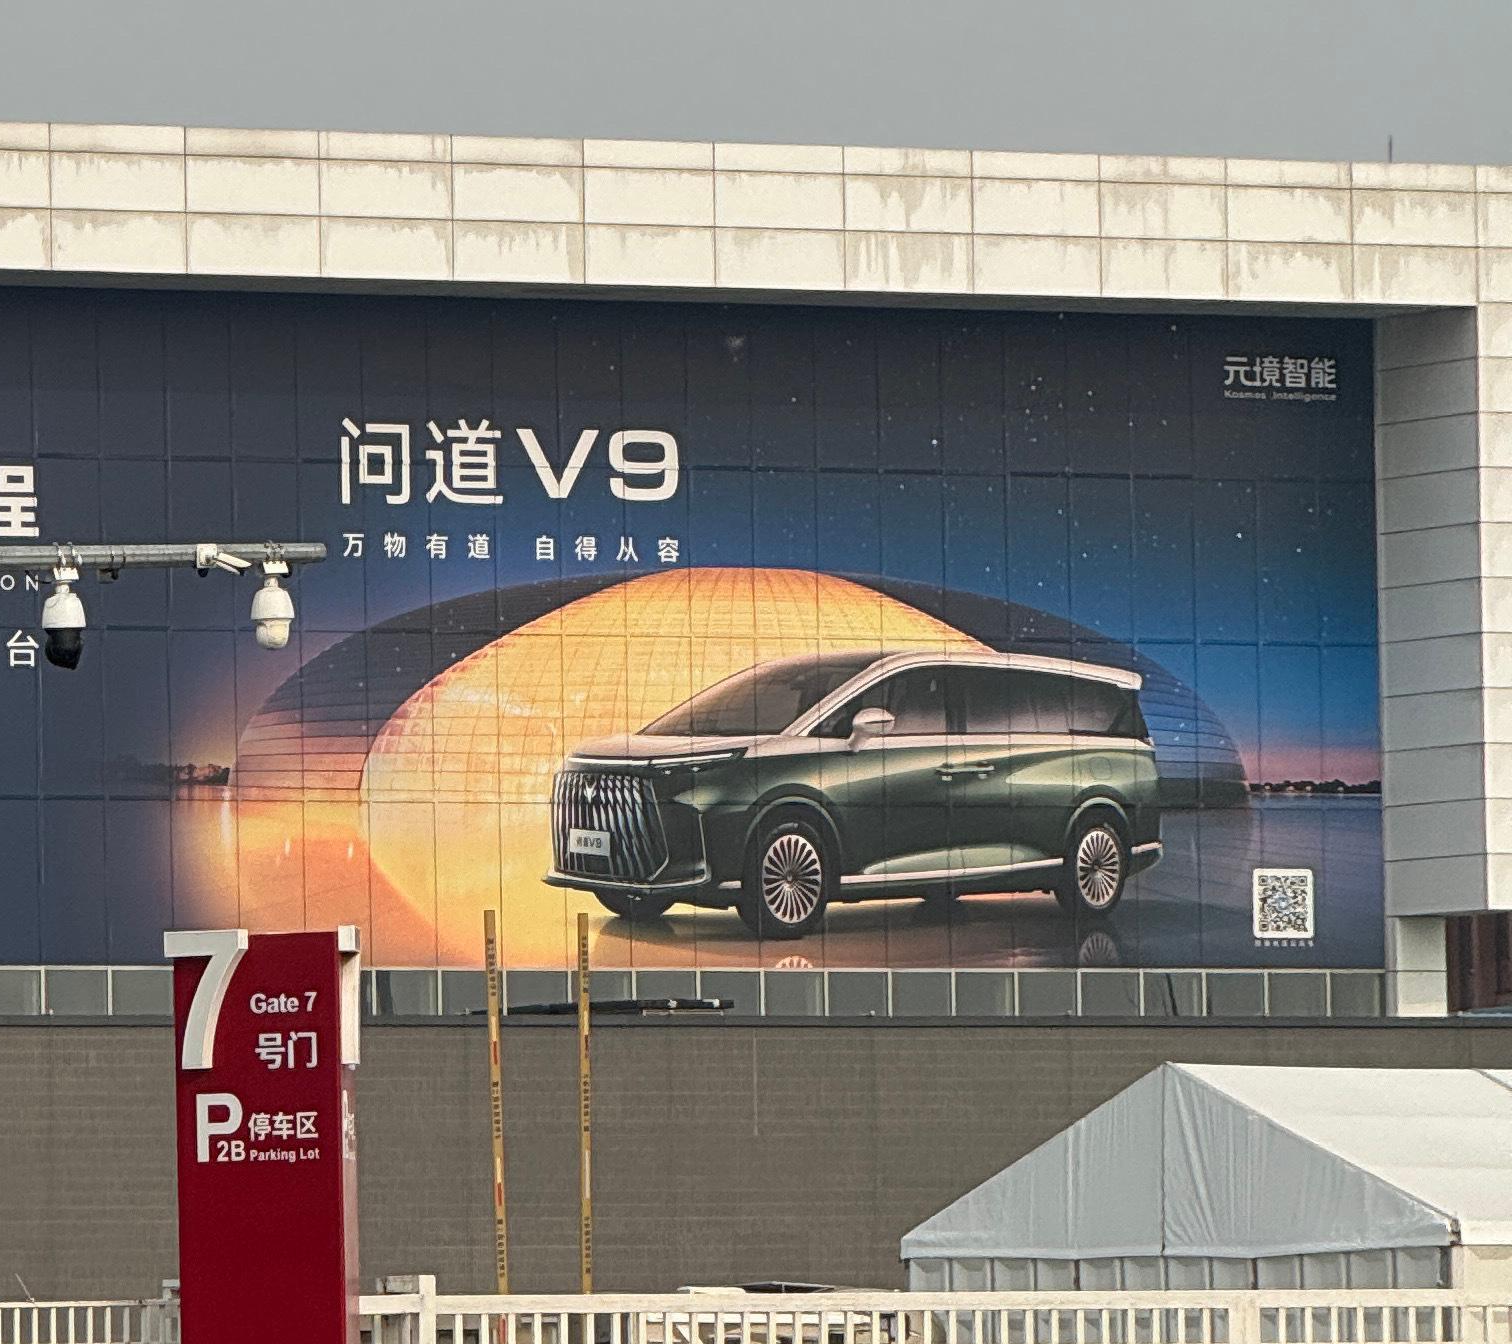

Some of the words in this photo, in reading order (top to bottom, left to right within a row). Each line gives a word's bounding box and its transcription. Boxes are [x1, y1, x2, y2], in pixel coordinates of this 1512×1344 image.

[1224, 355, 1337, 389] 元境智能
[1224, 389, 1266, 400] Kosmos
[1272, 390, 1337, 402] Intelligence
[339, 416, 681, 506] 问道V9
[342, 532, 491, 560] 万物有道
[535, 535, 681, 564] 自得从容
[163, 928, 249, 1070] 7
[249, 993, 299, 1015] Gate
[303, 991, 318, 1013] 7
[254, 1031, 319, 1071] 号门
[195, 1092, 243, 1164] P
[247, 1111, 319, 1141] 停车区
[216, 1140, 246, 1163] 2B
[249, 1147, 296, 1163] Parking
[299, 1147, 320, 1160] Lot
